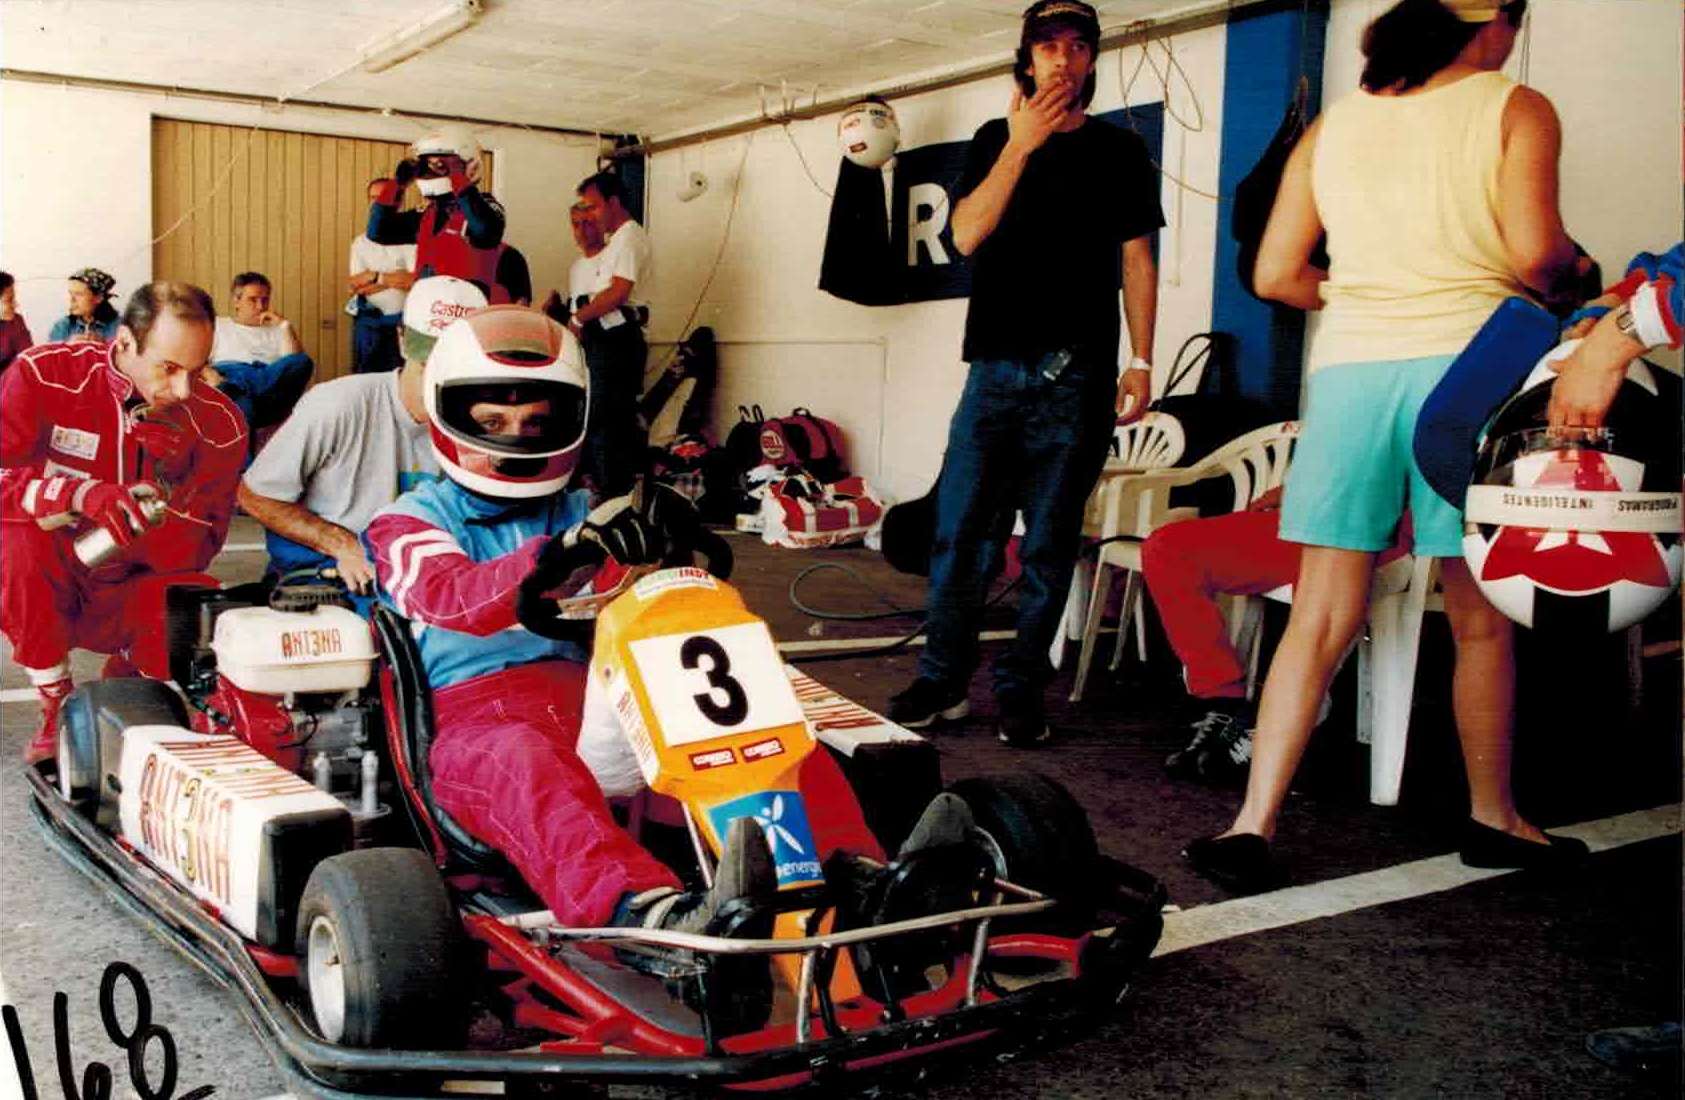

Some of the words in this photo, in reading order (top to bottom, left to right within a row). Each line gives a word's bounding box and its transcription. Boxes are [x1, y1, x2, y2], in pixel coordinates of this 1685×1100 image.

[1502, 492, 1594, 509] INTELIGENTES
[1617, 498, 1678, 513] PROGRAMAS
[680, 635, 749, 727] 3
